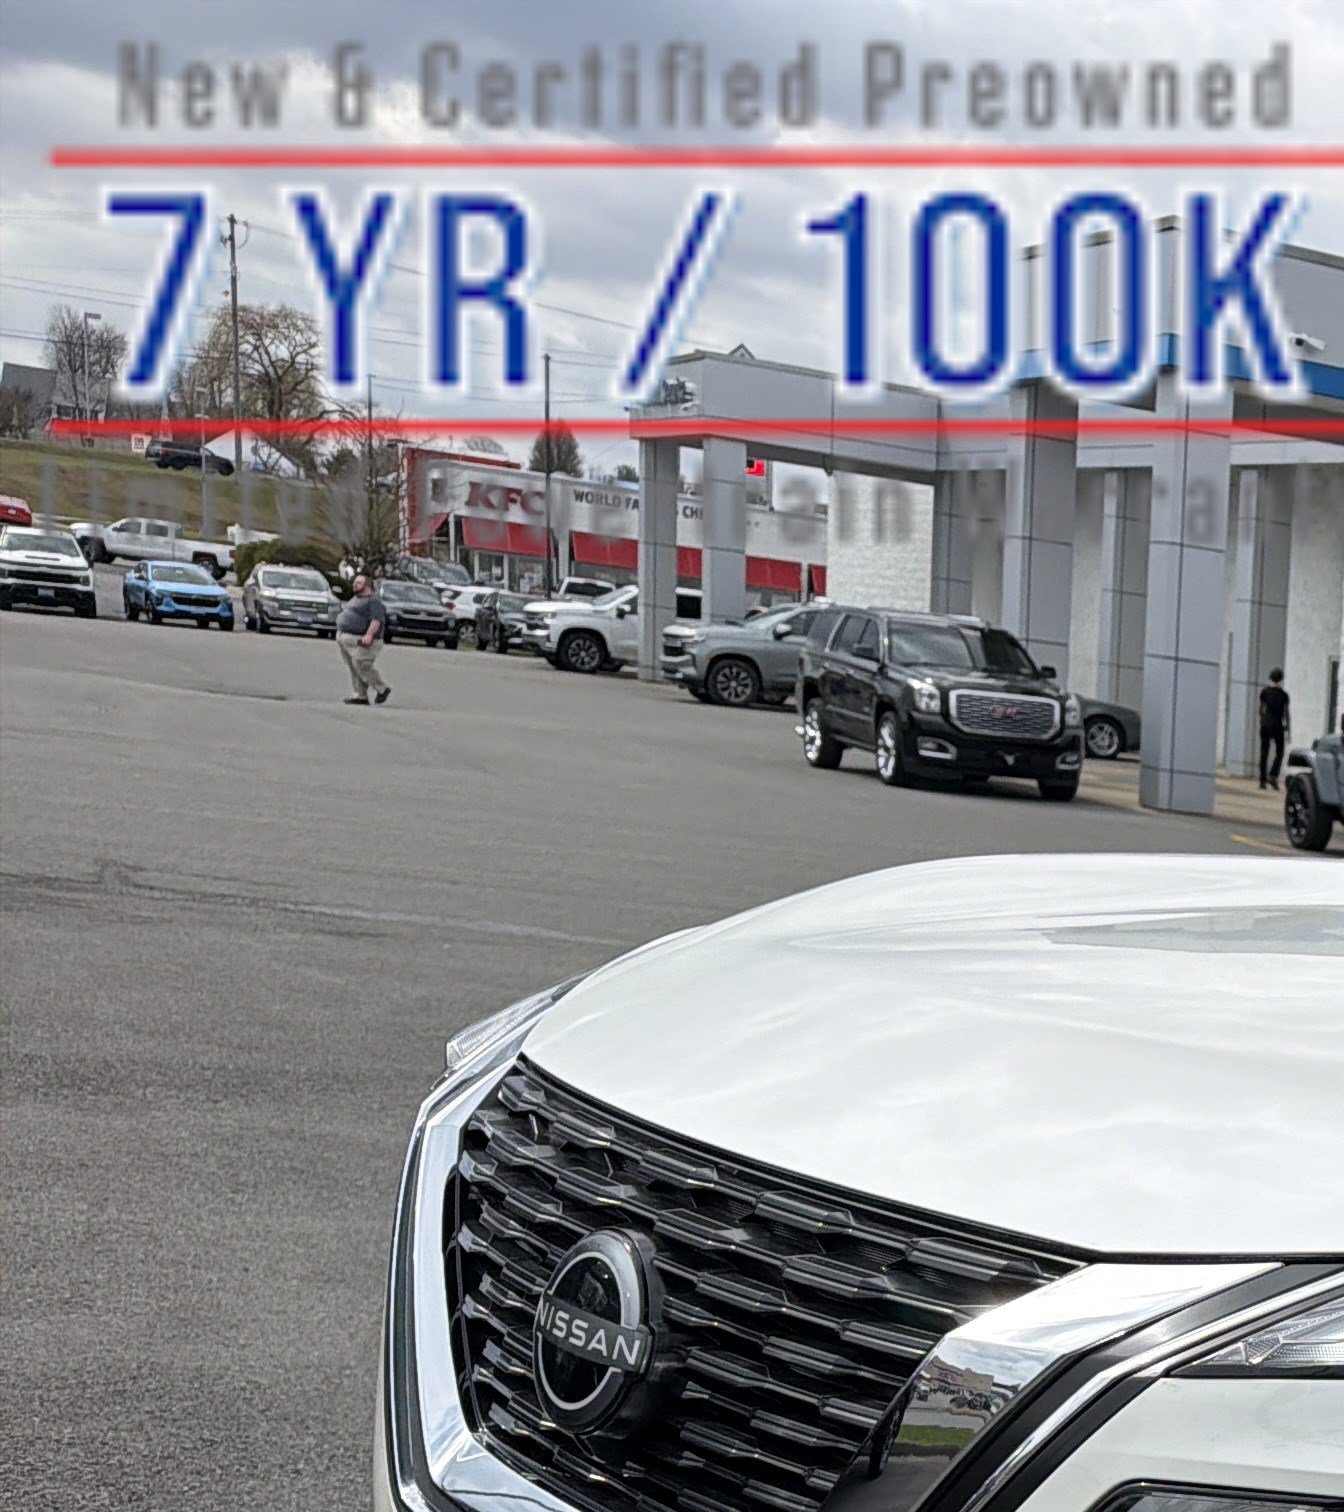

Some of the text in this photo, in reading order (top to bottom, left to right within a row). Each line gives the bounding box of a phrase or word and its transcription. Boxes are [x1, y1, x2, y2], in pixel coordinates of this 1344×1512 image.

[463, 481, 546, 516] KFC
[572, 488, 622, 508] WORLD
[536, 1299, 641, 1366] NISSAN
